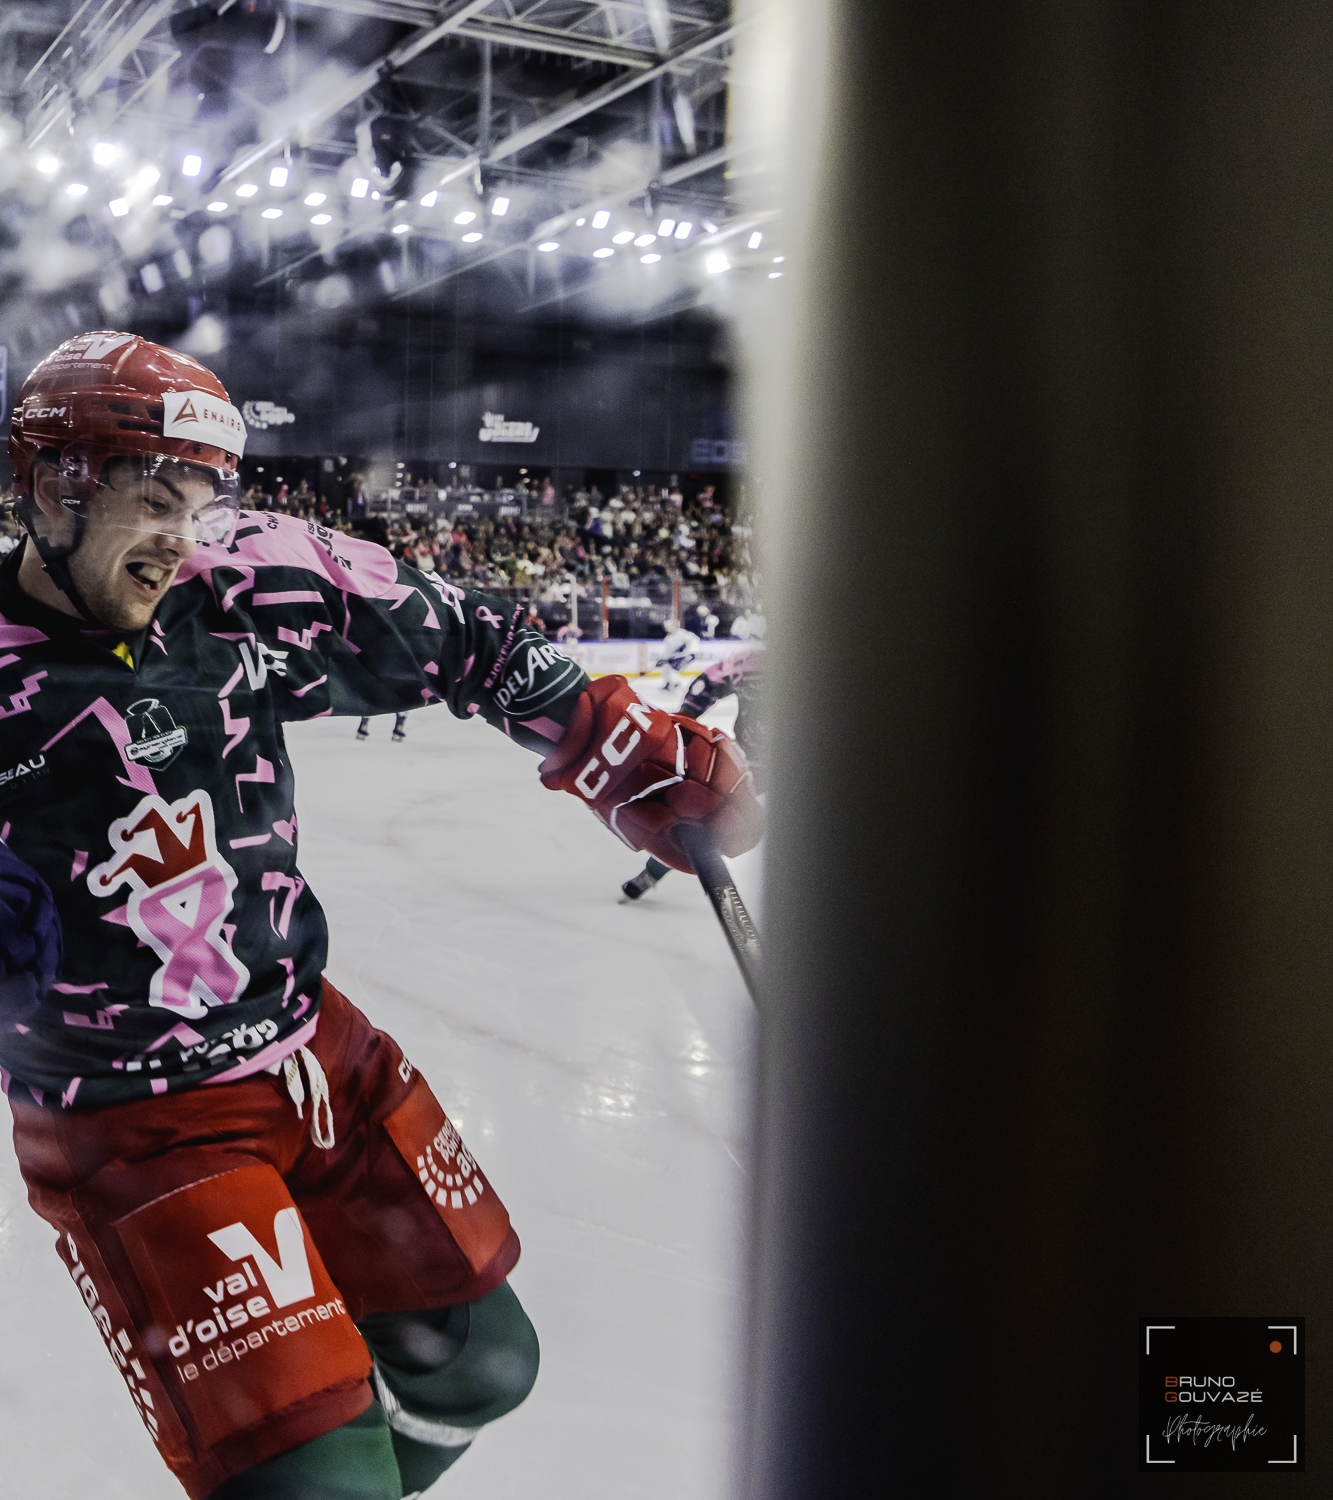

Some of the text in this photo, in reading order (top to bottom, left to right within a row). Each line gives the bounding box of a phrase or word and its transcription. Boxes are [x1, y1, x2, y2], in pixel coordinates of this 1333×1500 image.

[24, 406, 67, 419] CCM
[202, 1261, 259, 1303] val
[168, 1295, 271, 1358] d'oise
[176, 1297, 346, 1383] le département
